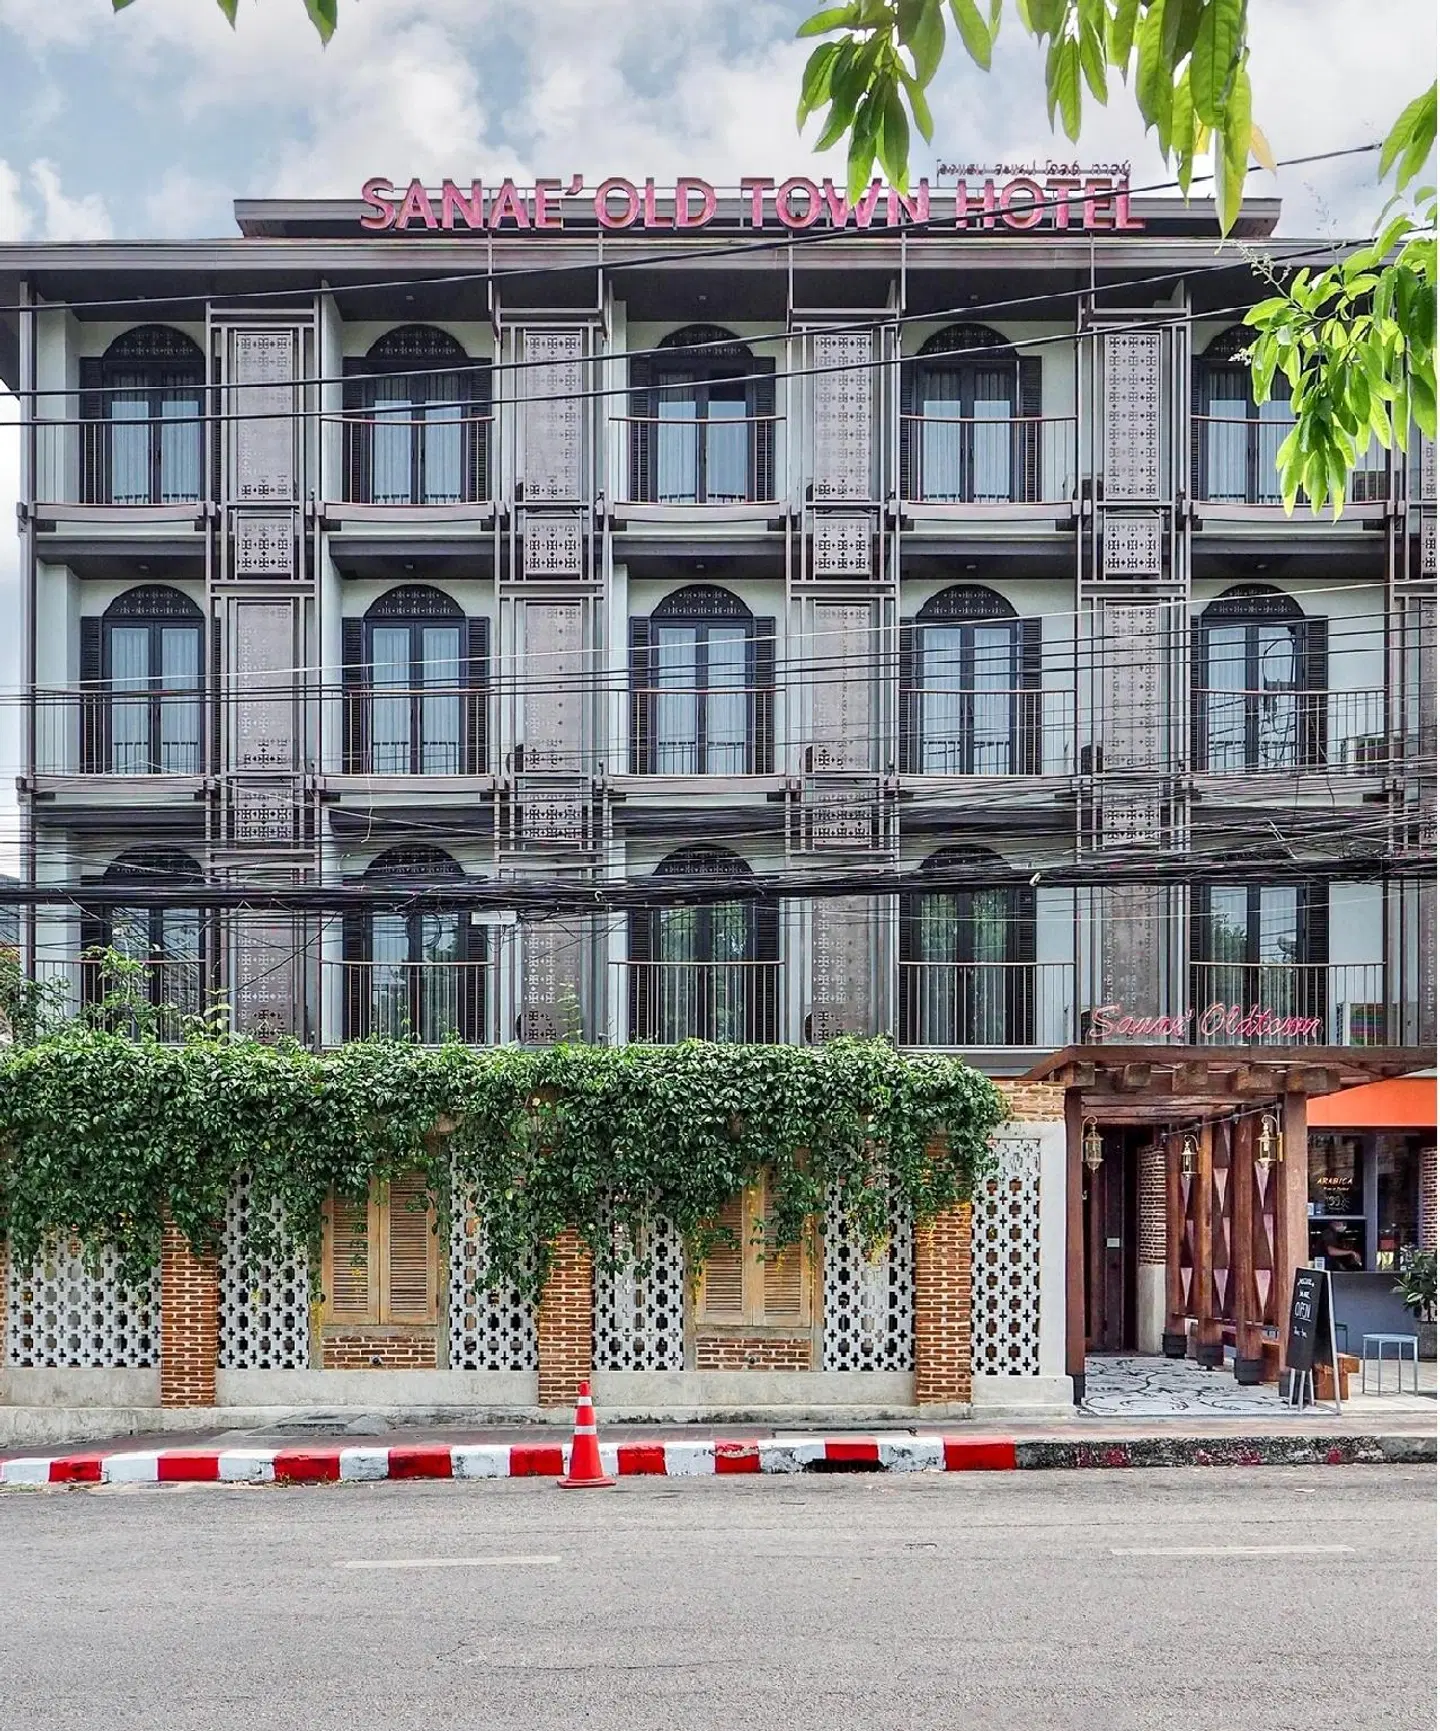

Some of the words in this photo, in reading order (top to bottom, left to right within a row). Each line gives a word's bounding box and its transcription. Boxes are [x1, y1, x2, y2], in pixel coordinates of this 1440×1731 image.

[594, 177, 717, 230] OLD
[740, 177, 930, 229] TOWN
[956, 177, 1147, 230] HOTEL
[1316, 1177, 1353, 1186] ARABICA
